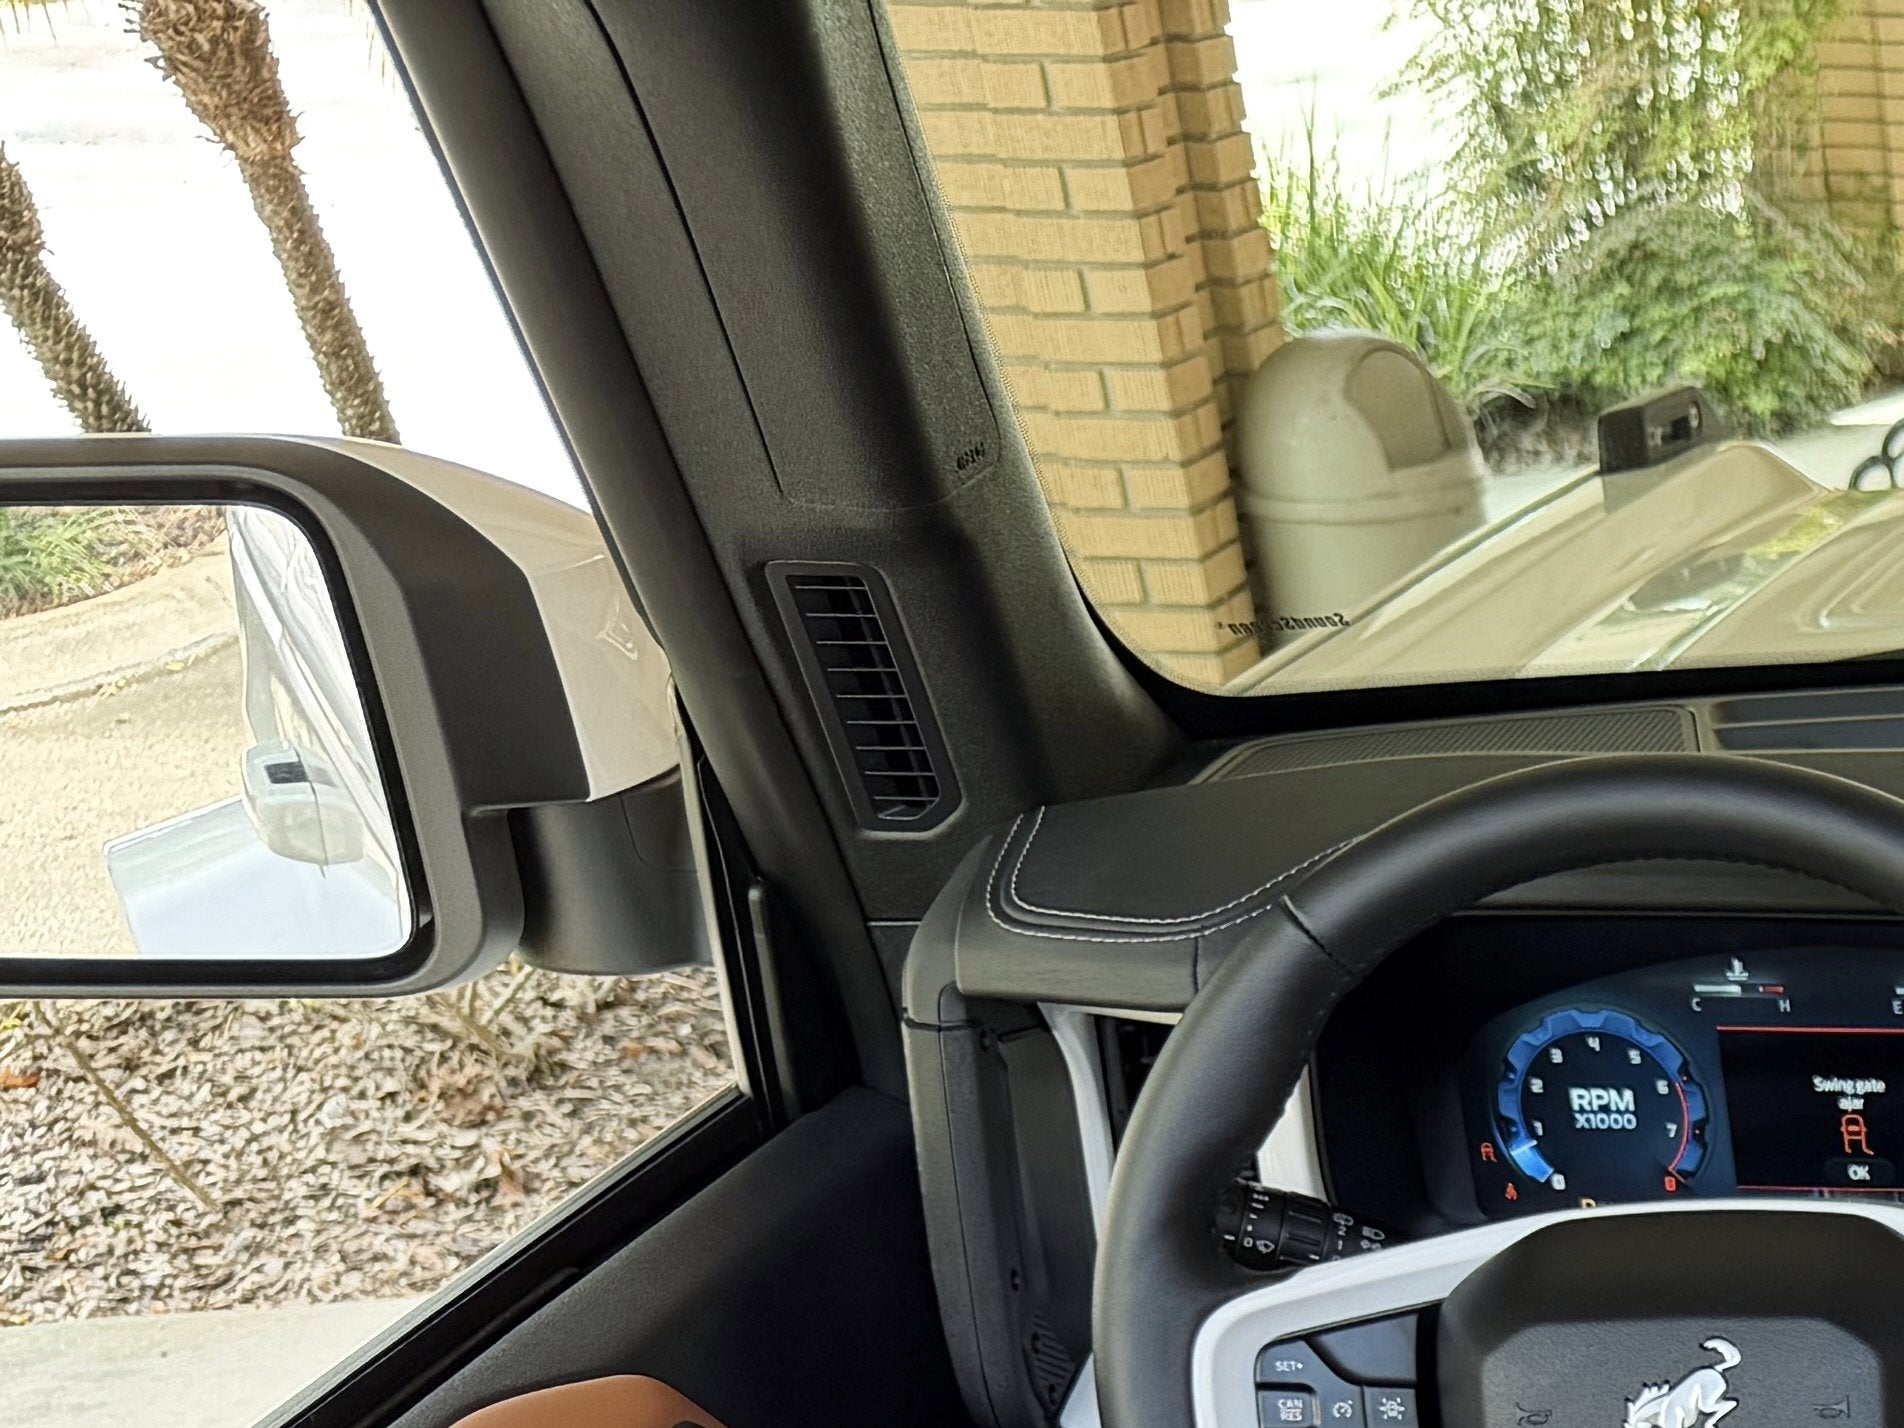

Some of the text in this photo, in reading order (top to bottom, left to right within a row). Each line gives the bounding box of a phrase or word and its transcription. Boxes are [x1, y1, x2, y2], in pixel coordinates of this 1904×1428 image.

[1692, 998, 1701, 1011] C
[1779, 999, 1790, 1012] H
[1893, 1001, 1902, 1014] E
[1586, 1035, 1600, 1051] 4
[1550, 1049, 1563, 1063] 3
[1627, 1049, 1642, 1064] 5
[1529, 1077, 1544, 1093] 2
[1655, 1079, 1669, 1095] 6
[1812, 1075, 1885, 1095] Swing gate
[1569, 1087, 1635, 1111] RPM
[1837, 1096, 1864, 1112] ajar
[1532, 1120, 1543, 1136] 1
[1574, 1113, 1637, 1129] X1000
[1665, 1122, 1677, 1138] 7
[1847, 1164, 1870, 1181] OK
[1551, 1173, 1566, 1191] 0
